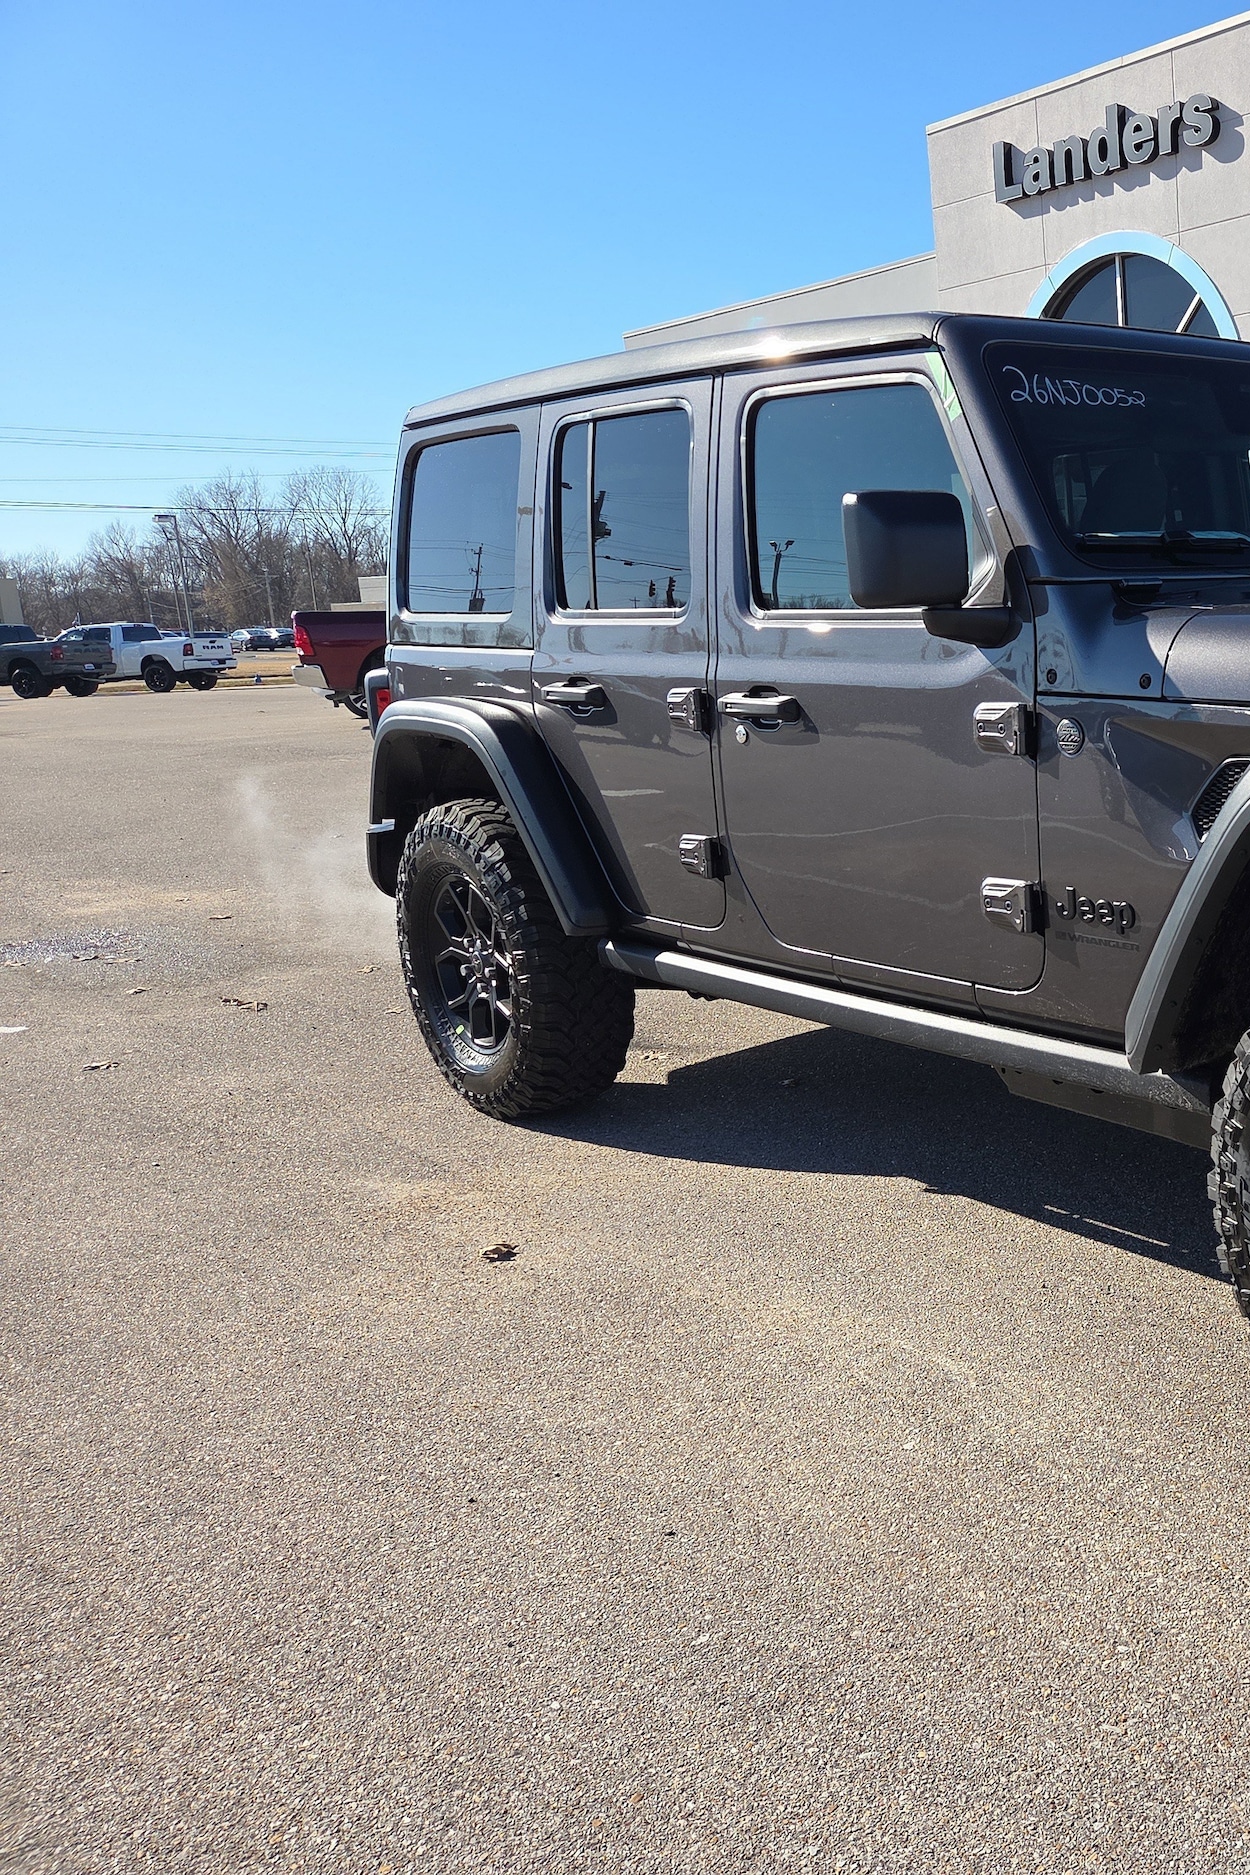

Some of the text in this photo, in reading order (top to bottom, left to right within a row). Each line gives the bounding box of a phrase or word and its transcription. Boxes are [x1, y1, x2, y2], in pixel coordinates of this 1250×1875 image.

[992, 93, 1220, 204] Landers
[1056, 886, 1136, 935] Jeep
[1067, 932, 1140, 952] WRANGLER
